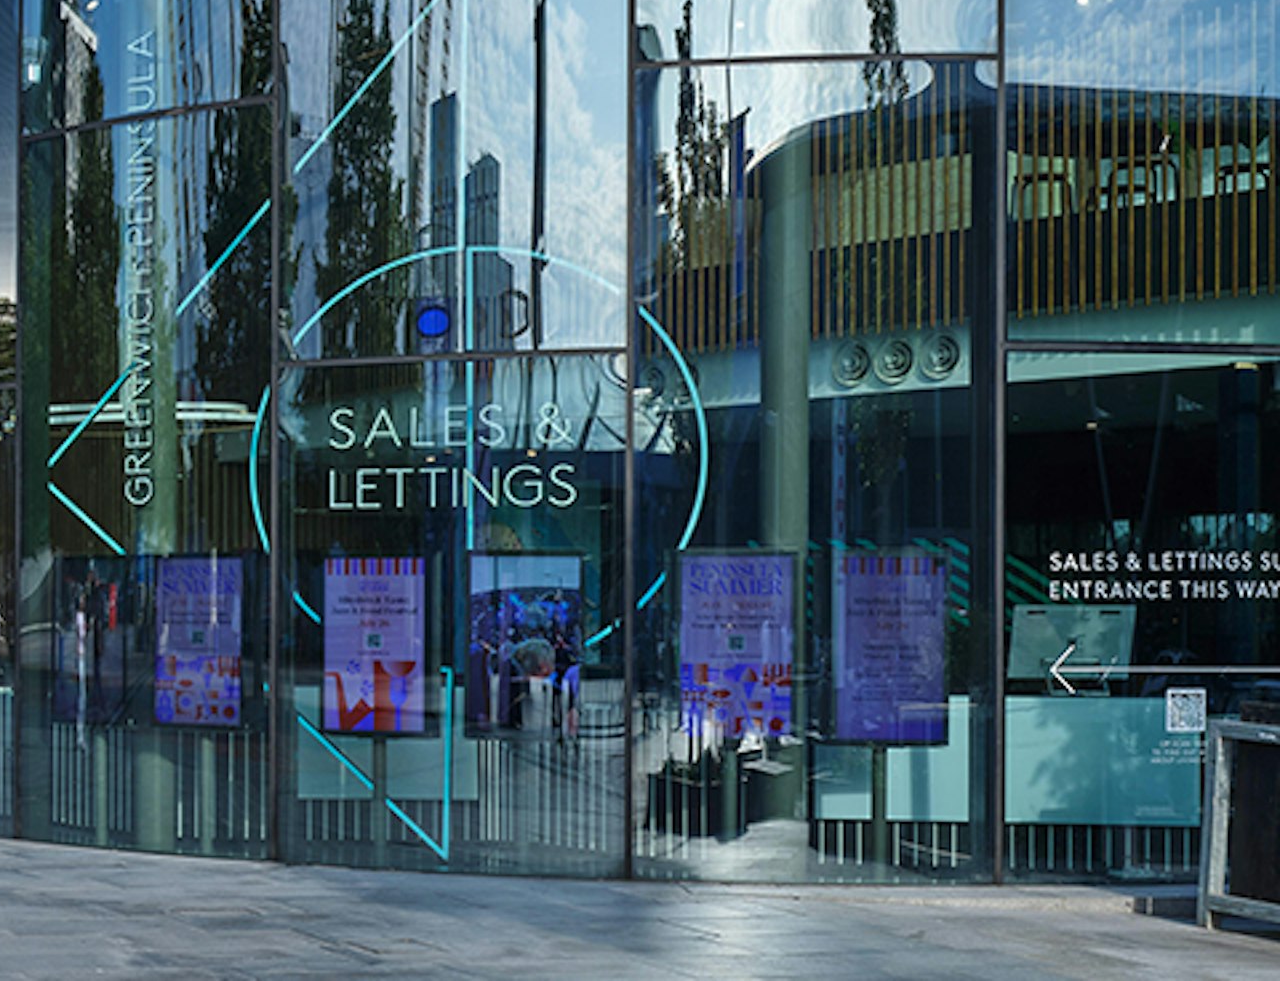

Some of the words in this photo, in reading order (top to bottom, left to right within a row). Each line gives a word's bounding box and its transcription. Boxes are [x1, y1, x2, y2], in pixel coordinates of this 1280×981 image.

[126, 30, 156, 247] PENINSULA
[124, 270, 155, 506] GREENWICH
[328, 404, 506, 450] SALES
[535, 401, 575, 446] &
[328, 462, 578, 509] LETTINGS
[1049, 550, 1119, 572] SALES
[1124, 550, 1142, 572] &
[1147, 550, 1253, 572] LETTINGS
[689, 579, 783, 595] SUMMER
[1048, 579, 1173, 601] ENTRANCE
[1179, 579, 1230, 600] THIS
[1235, 579, 1280, 600] WAY
